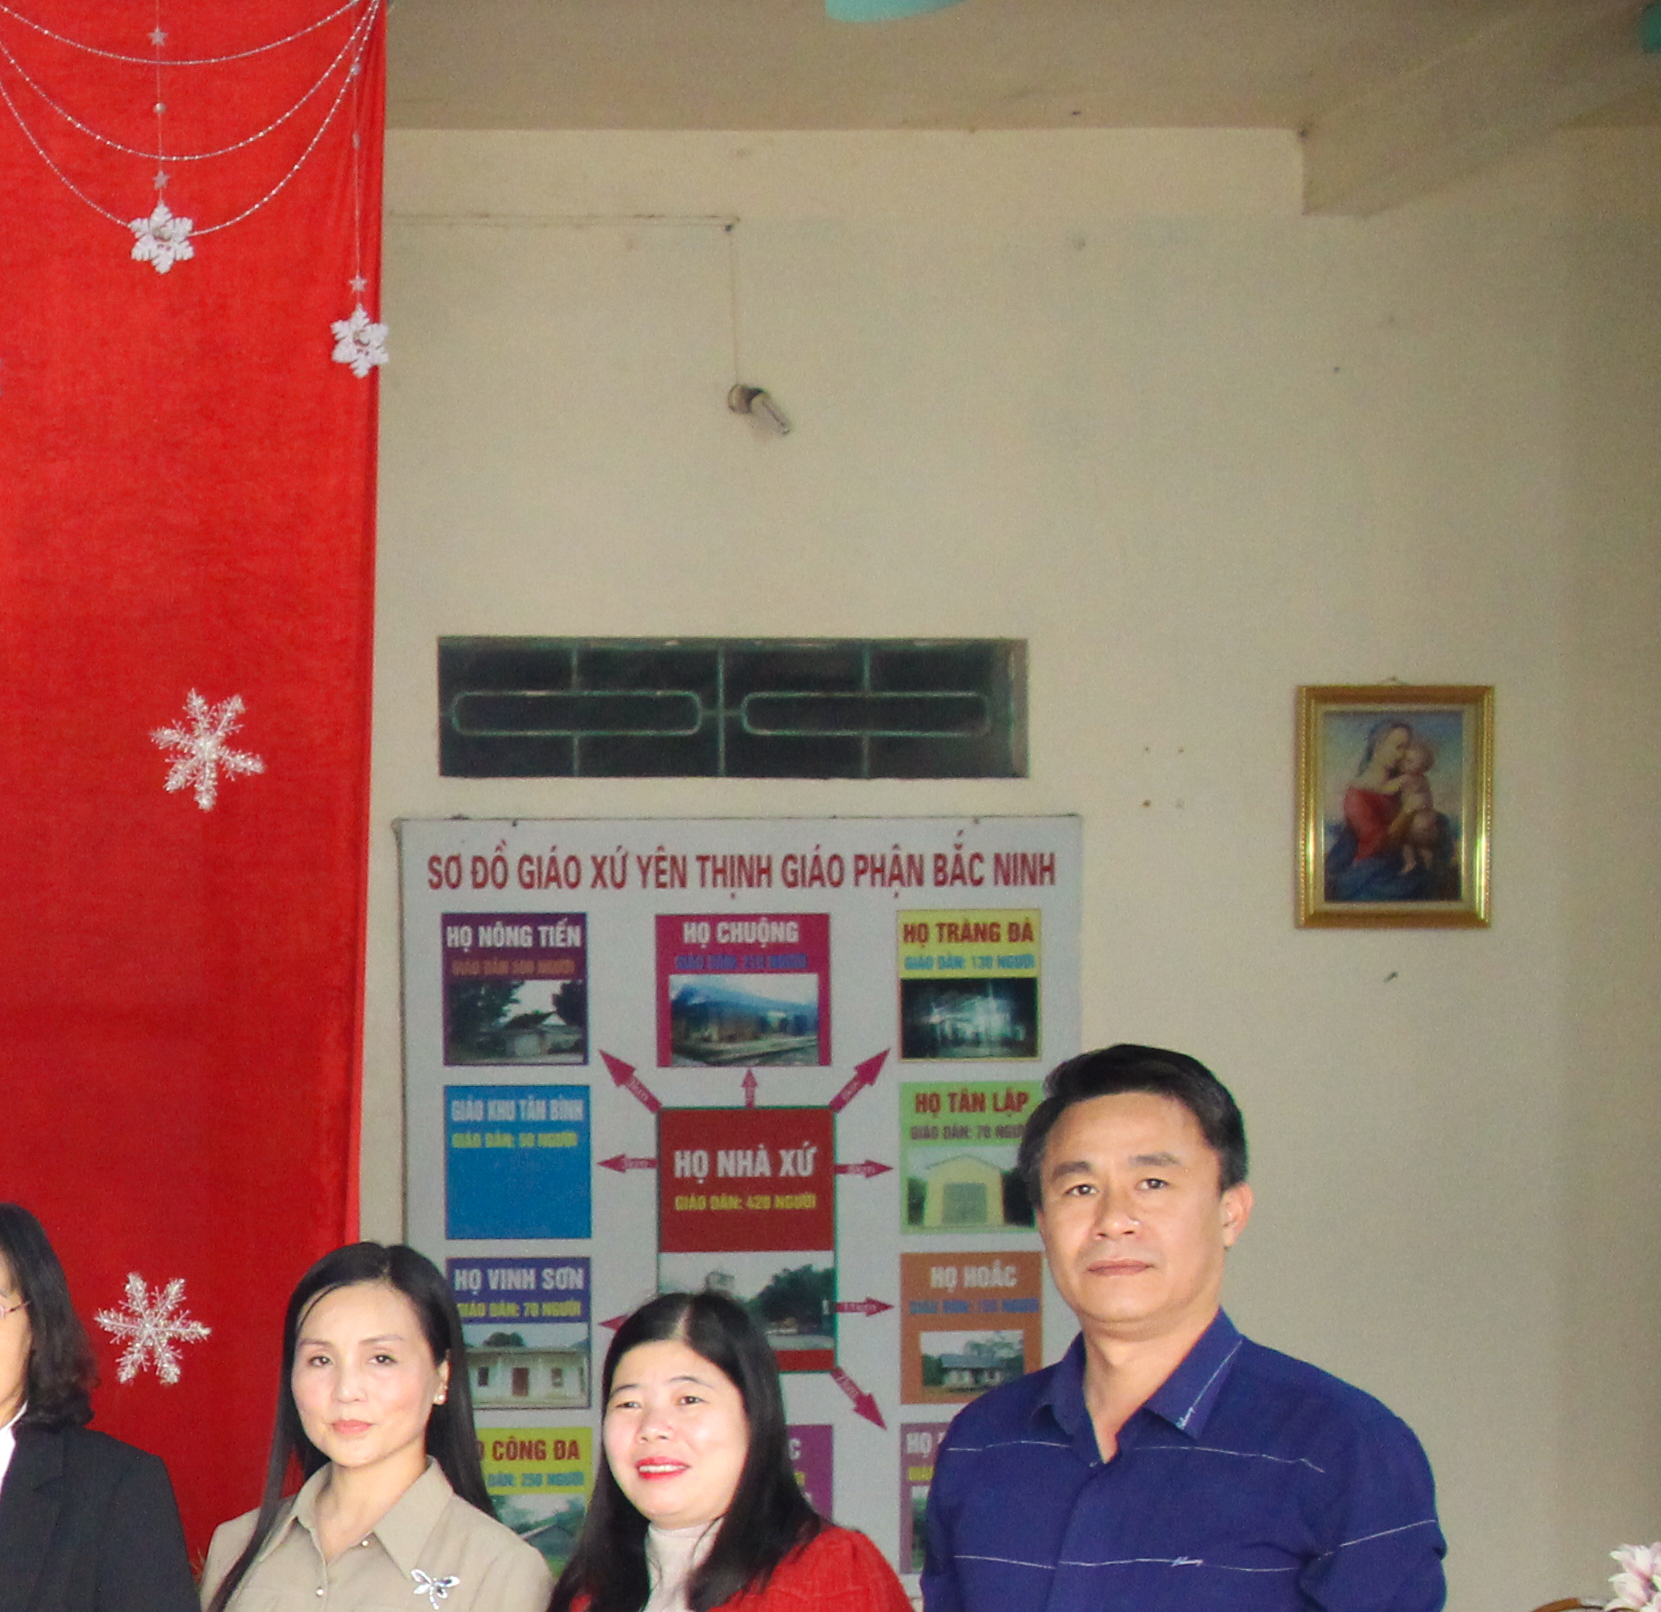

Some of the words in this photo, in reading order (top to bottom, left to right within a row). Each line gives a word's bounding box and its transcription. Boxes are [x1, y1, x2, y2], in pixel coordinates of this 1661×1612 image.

[427, 852, 464, 890] SƠ
[470, 838, 509, 890] ĐỒ
[517, 845, 582, 890] GIÁO
[589, 844, 630, 889] XỨ
[635, 845, 688, 889] YÊN
[695, 853, 773, 899] THỊNH
[781, 844, 846, 888] GIÁO
[853, 843, 925, 899] PHẬN
[932, 829, 985, 888] BẮC
[993, 852, 1056, 887] NINH
[446, 925, 473, 952] HỌ
[478, 921, 534, 948] NÔNG
[537, 917, 582, 947] TIẾN
[682, 921, 712, 949] HỌ
[715, 916, 800, 949] CHUỘNG
[902, 922, 929, 948] HỌ
[914, 1092, 942, 1118] HỌ
[946, 1088, 987, 1113] TÂN
[991, 1086, 1030, 1118] LẬP
[674, 1149, 710, 1185] HỌ
[716, 1143, 772, 1178] NHÀ
[778, 1140, 819, 1178] XỨ
[454, 1268, 483, 1295] HỌ
[487, 1267, 537, 1290] VINH
[541, 1266, 585, 1291] SƠN
[929, 1265, 959, 1293] HỌ
[492, 1436, 547, 1461] CÔNG
[905, 1431, 934, 1458] HỌ
